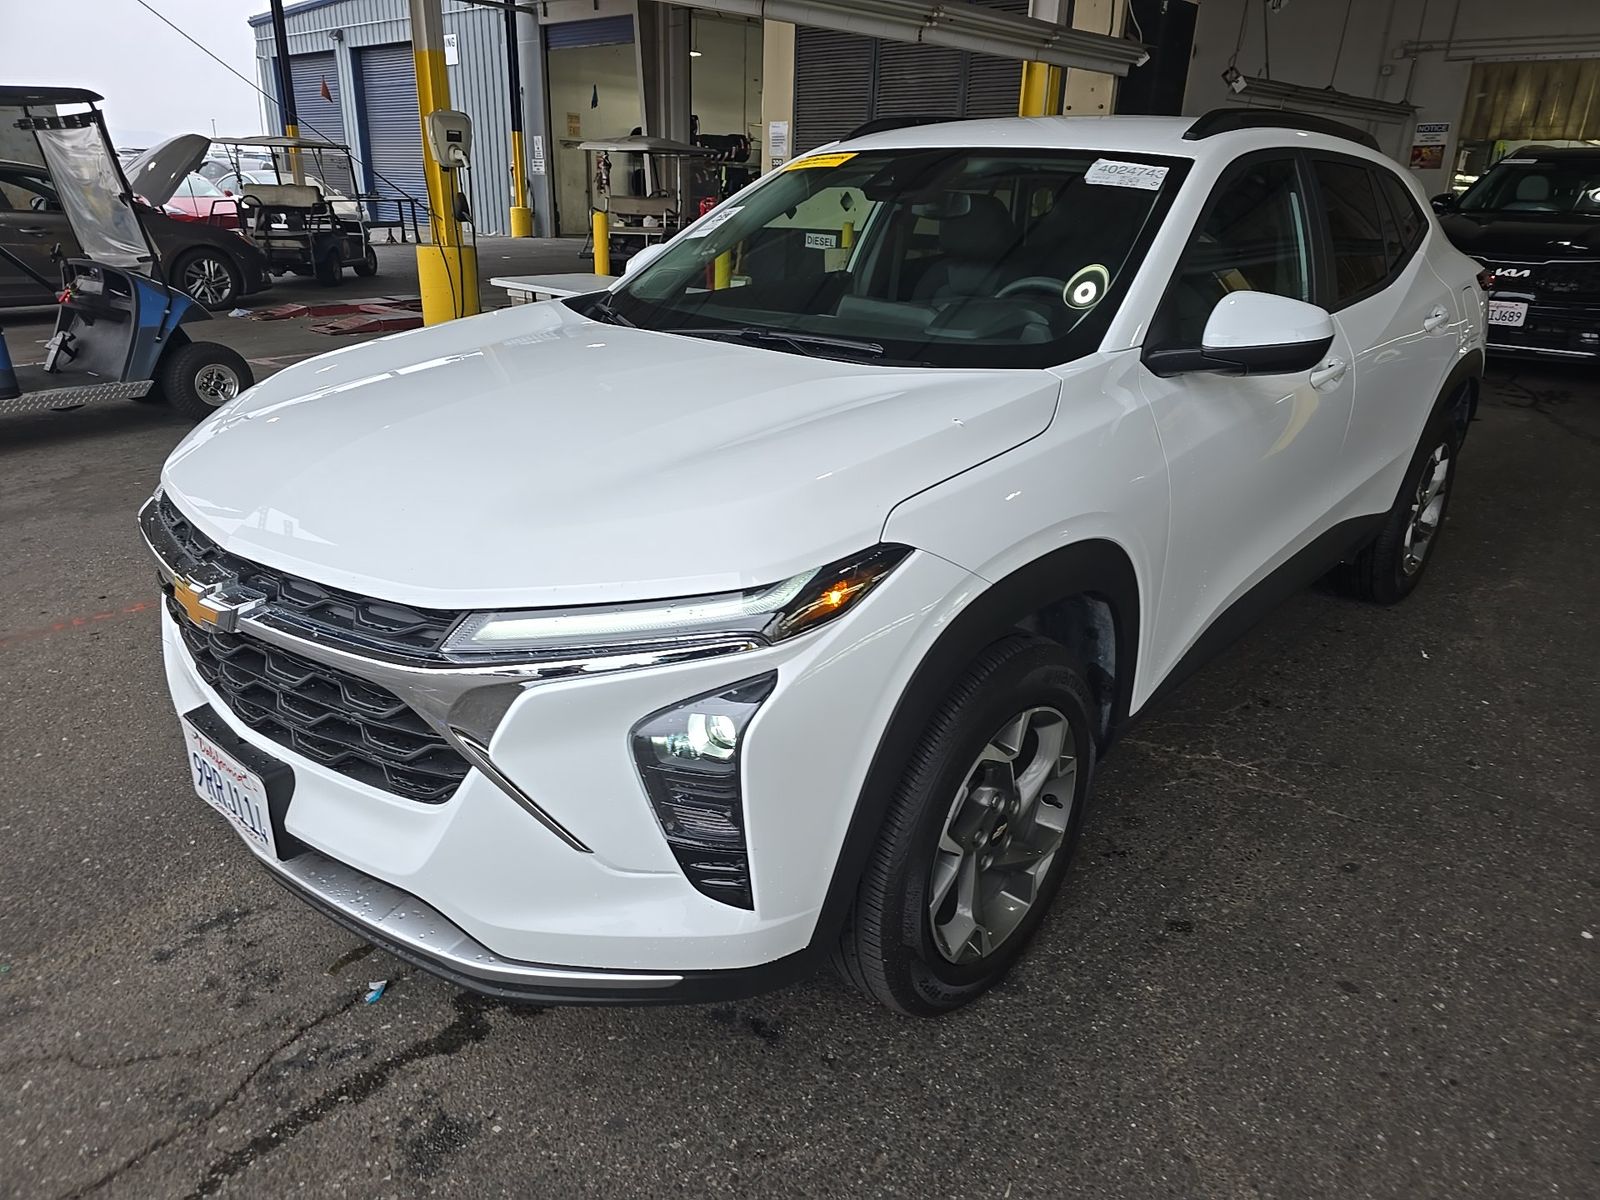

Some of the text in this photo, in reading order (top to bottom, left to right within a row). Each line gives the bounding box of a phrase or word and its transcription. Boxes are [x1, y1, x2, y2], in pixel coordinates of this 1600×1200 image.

[1098, 164, 1165, 179] 4024743
[807, 235, 834, 247] DIESEL
[1488, 309, 1522, 322] IJ689
